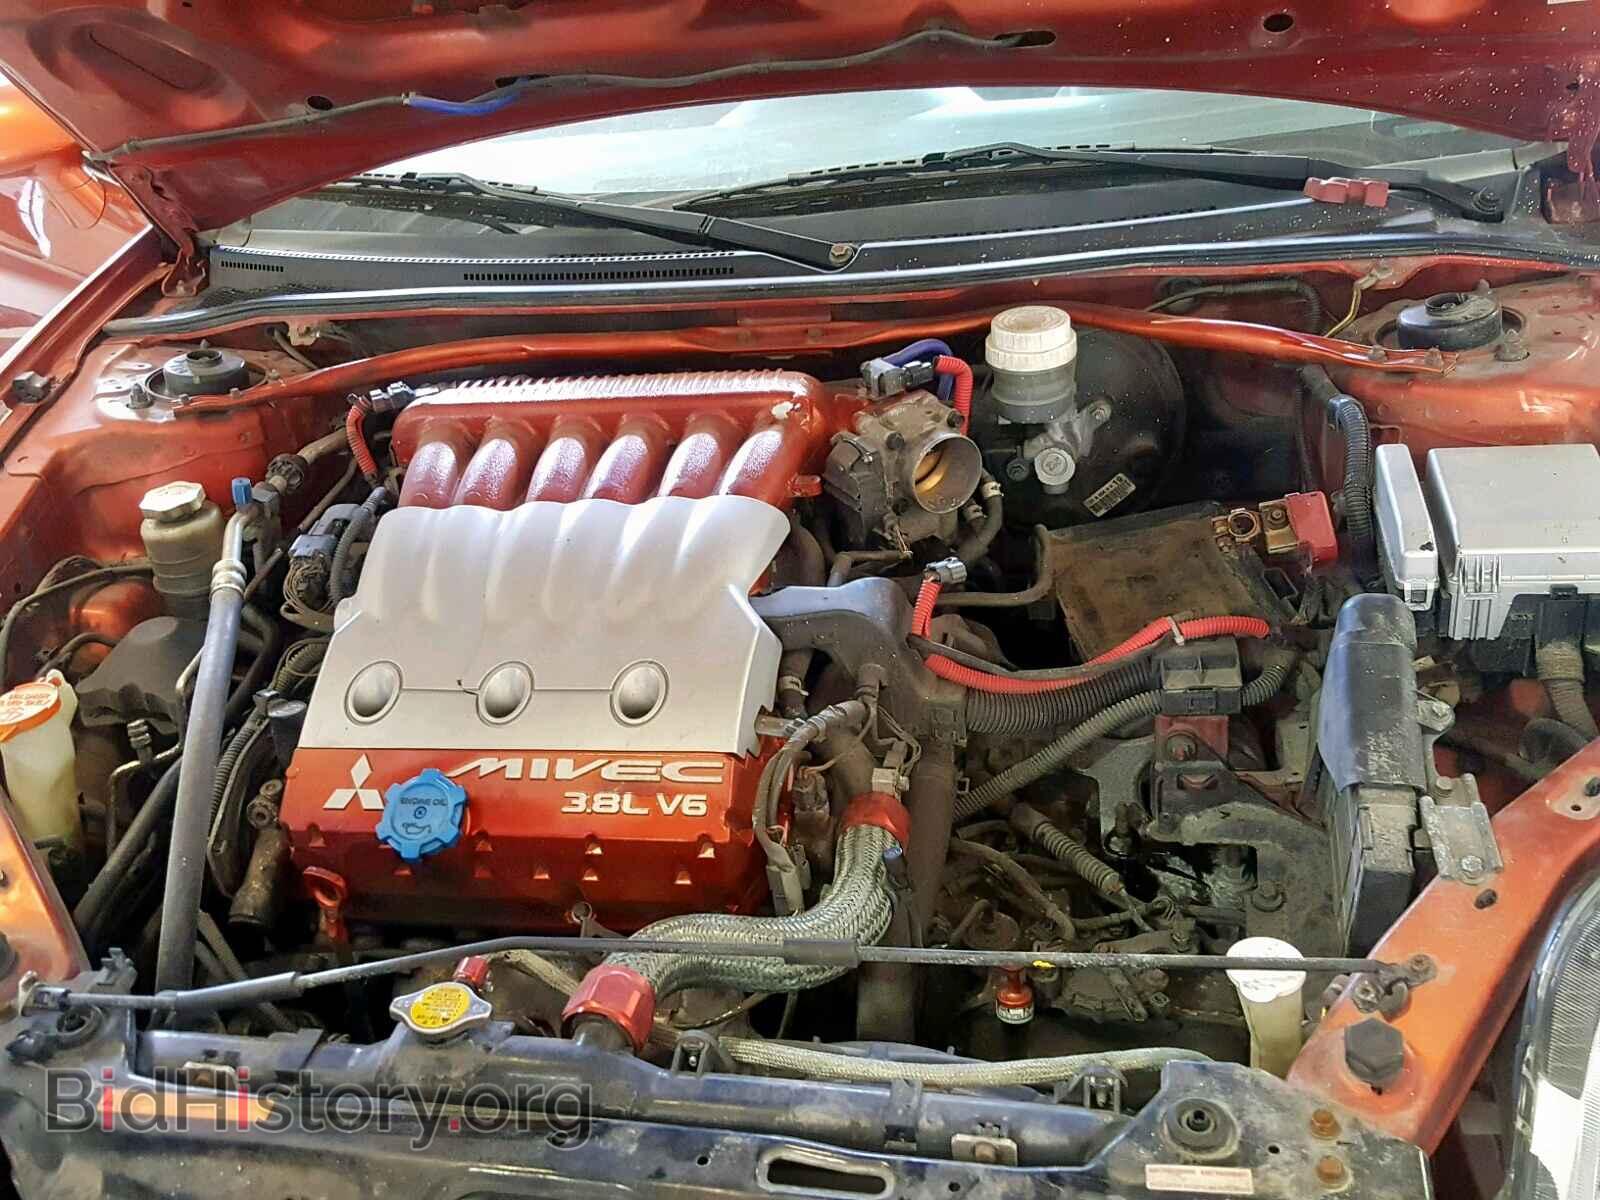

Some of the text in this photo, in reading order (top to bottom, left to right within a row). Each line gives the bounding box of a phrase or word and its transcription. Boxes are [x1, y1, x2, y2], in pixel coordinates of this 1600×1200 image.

[446, 757, 724, 783] MIVEC
[561, 791, 708, 816] 3.8L V6
